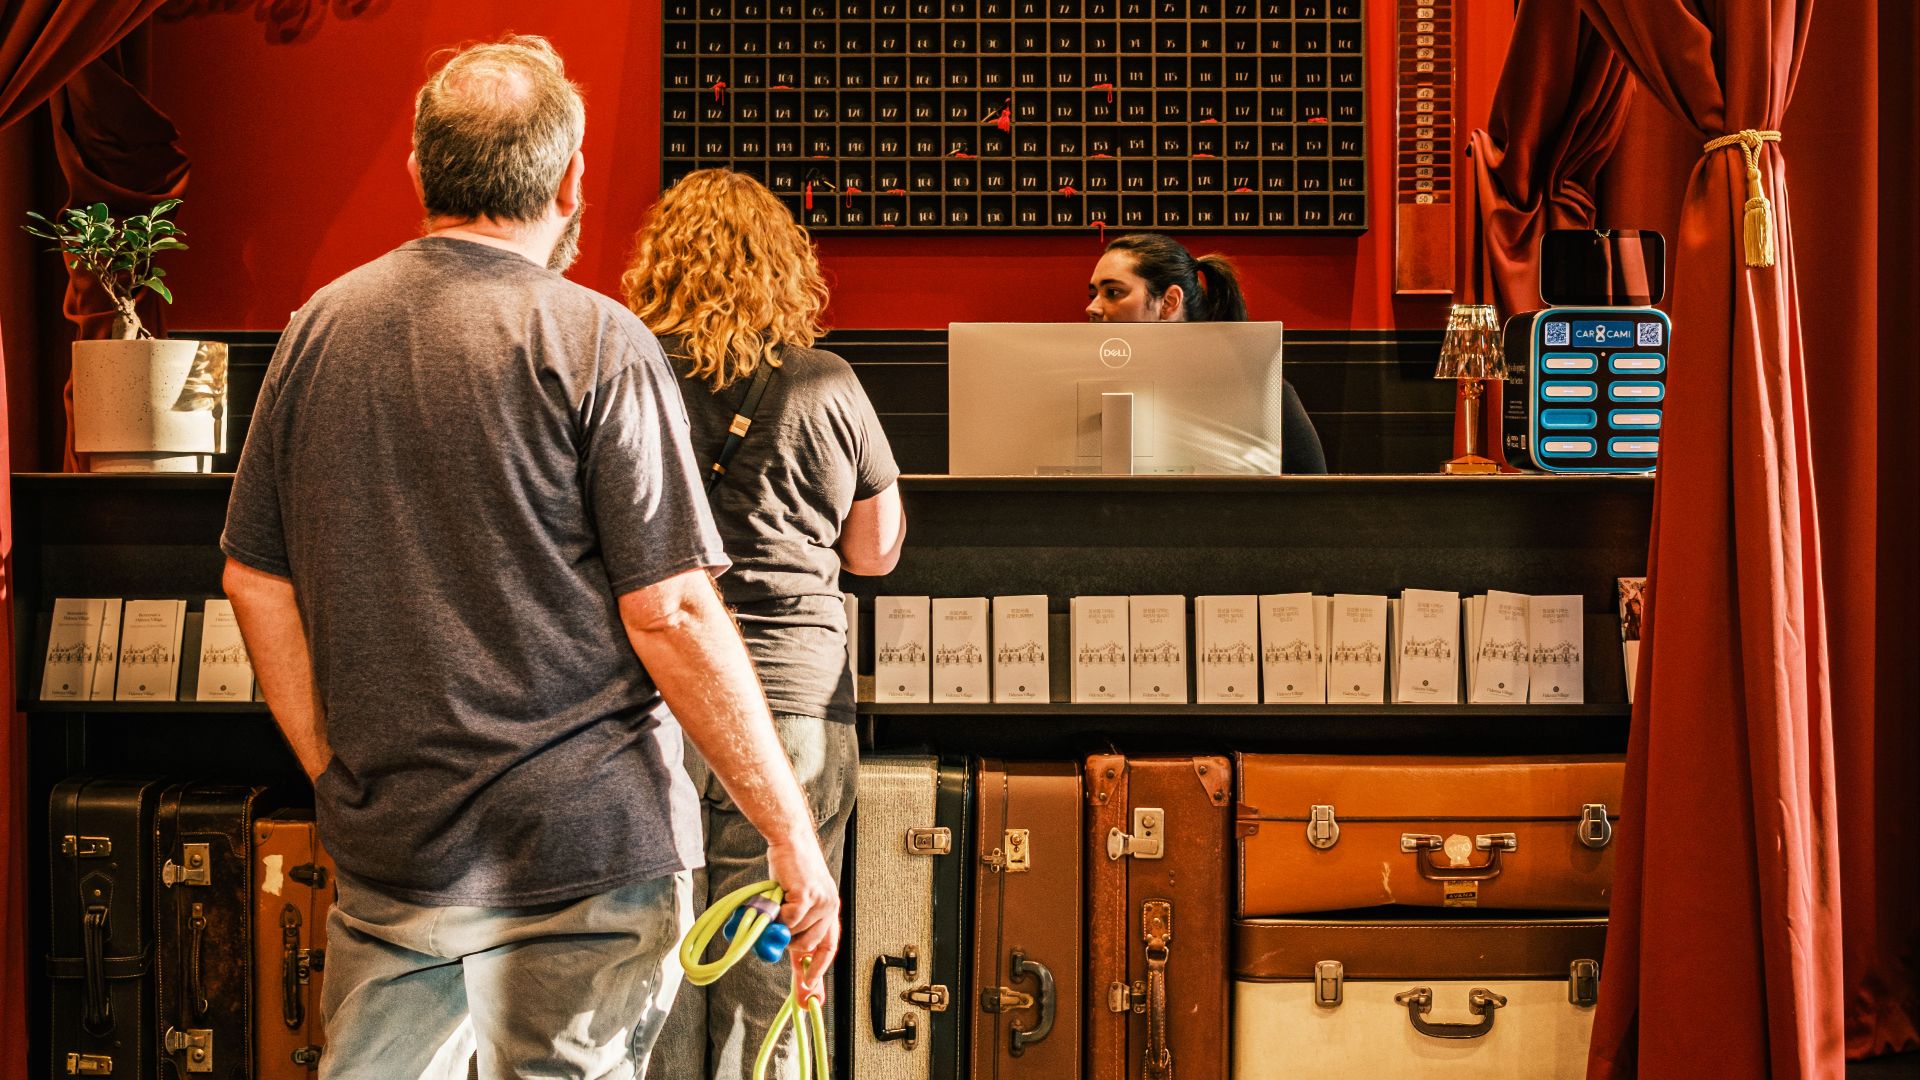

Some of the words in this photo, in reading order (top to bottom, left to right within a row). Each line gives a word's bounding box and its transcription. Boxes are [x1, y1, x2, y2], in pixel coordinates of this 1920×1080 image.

[676, 7, 686, 15] 61
[710, 8, 722, 17] 62
[745, 6, 757, 15] 63
[780, 6, 792, 15] 64
[812, 7, 824, 16] 65
[883, 5, 896, 15] 67
[951, 4, 964, 13] 69
[1023, 4, 1034, 14] 71
[1058, 4, 1070, 14] 72
[1093, 4, 1105, 14] 73
[1127, 4, 1139, 14] 74
[1163, 3, 1175, 12] 75
[1235, 5, 1247, 14] 77
[1304, 7, 1316, 16] 79
[1421, 10, 1429, 18] 36
[1421, 23, 1429, 31] 37
[676, 41, 686, 50] 81
[709, 42, 721, 52] 82
[743, 42, 756, 52] 83
[778, 41, 790, 50] 84
[813, 40, 826, 49] 85
[882, 39, 895, 49] 87
[952, 39, 966, 49] 89
[1024, 38, 1034, 48] 91
[1059, 39, 1070, 48] 92
[1094, 39, 1106, 48] 93
[1129, 39, 1140, 48] 94
[1165, 39, 1176, 48] 95
[1234, 41, 1245, 50] 97
[1421, 49, 1429, 57] 39
[674, 75, 688, 85] 101
[706, 74, 721, 83] 102
[744, 74, 759, 84] 103
[778, 73, 794, 83] 104
[814, 75, 830, 85] 105
[883, 75, 899, 85] 107
[952, 75, 968, 84] 109
[1022, 74, 1034, 83] 111
[1058, 73, 1072, 83] 112
[1094, 73, 1108, 82] 113
[1129, 72, 1143, 81] 114
[1164, 72, 1178, 81] 115
[1235, 72, 1249, 81] 117
[1306, 74, 1321, 83] 119
[673, 109, 686, 119] 121
[707, 109, 722, 119] 122
[743, 109, 758, 118] 123
[775, 109, 790, 119] 124
[814, 108, 829, 118] 125
[882, 108, 898, 118] 127
[952, 107, 968, 117] 129
[1021, 106, 1035, 116] 131
[1057, 107, 1072, 117] 132
[1094, 106, 1109, 116] 133
[1129, 106, 1144, 115] 134
[1165, 105, 1180, 115] 135
[1235, 106, 1250, 116] 137
[1305, 107, 1320, 116] 139
[671, 143, 685, 153] 141
[706, 143, 722, 153] 142
[743, 143, 759, 152] 143
[776, 142, 793, 152] 144
[814, 142, 830, 152] 145
[881, 142, 898, 152] 147
[1023, 142, 1037, 152] 151
[1060, 143, 1075, 153] 152
[1093, 141, 1109, 151] 153
[1129, 139, 1144, 149] 154
[1164, 141, 1179, 150] 155
[1235, 140, 1250, 150] 157
[1306, 141, 1321, 150] 159
[1419, 142, 1429, 150] 46
[1420, 155, 1429, 163] 47
[1420, 168, 1428, 176] 48
[776, 177, 792, 187] 164
[882, 177, 898, 188] 167
[953, 177, 970, 187] 169
[1022, 177, 1036, 187] 171
[1059, 176, 1074, 186] 172
[1091, 177, 1107, 187] 173
[1128, 177, 1143, 187] 174
[1163, 177, 1179, 187] 175
[1233, 177, 1249, 186] 177
[1304, 179, 1320, 189] 179
[1419, 195, 1428, 203] 50
[812, 213, 828, 223] 185
[883, 212, 899, 222] 187
[951, 212, 968, 222] 189
[1022, 212, 1036, 222] 191
[1057, 213, 1072, 223] 192
[1091, 211, 1107, 221] 193
[1126, 211, 1142, 221] 194
[1164, 212, 1180, 222] 195
[1234, 212, 1250, 222] 197
[1305, 210, 1321, 220] 199
[1575, 329, 1595, 338] CAR
[1606, 329, 1631, 338] CAMI
[1103, 349, 1128, 357] DELL
